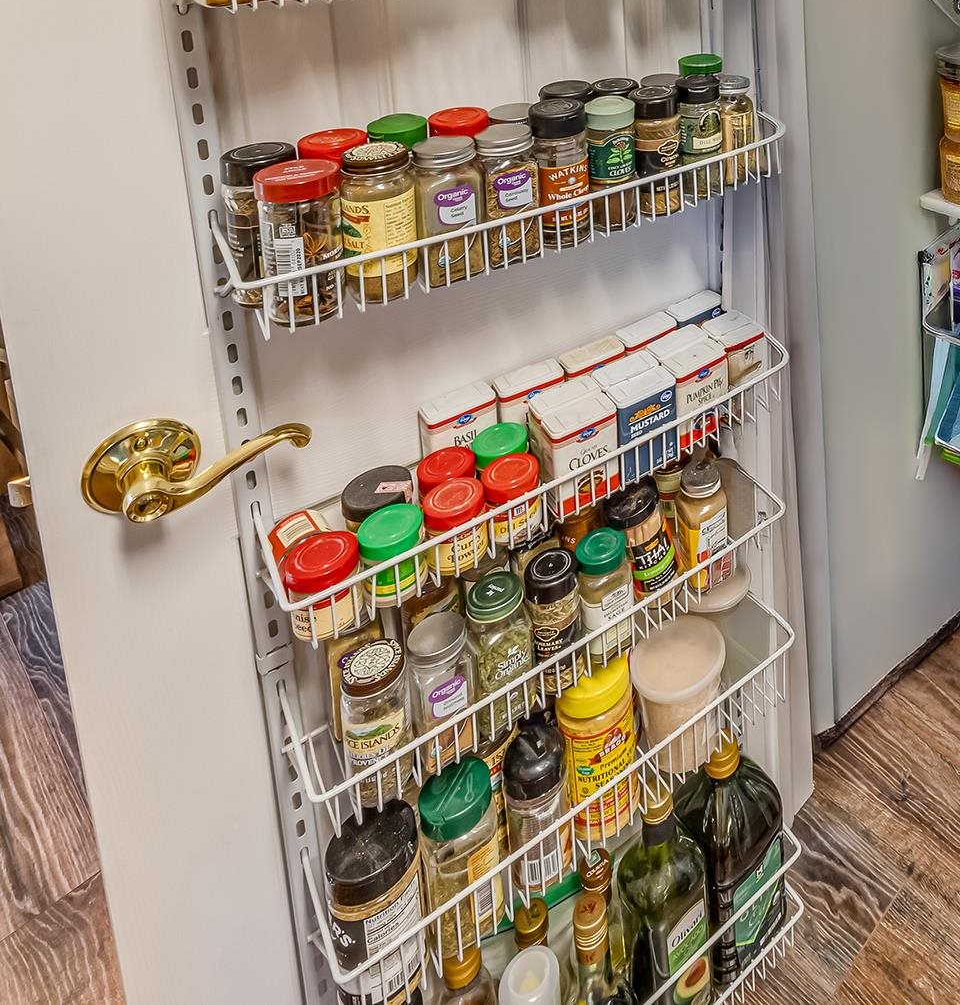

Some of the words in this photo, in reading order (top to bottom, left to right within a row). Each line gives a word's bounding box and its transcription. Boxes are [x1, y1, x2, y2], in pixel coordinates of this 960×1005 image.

[497, 172, 527, 185] Organic
[548, 164, 588, 182] WATKINS
[437, 188, 469, 201] Organic
[547, 190, 573, 201] Whole
[630, 408, 671, 434] MUSTARD
[568, 444, 609, 472] CLOVES
[635, 536, 671, 566] THAI
[494, 654, 531, 681] Organic
[497, 648, 527, 670] Simply
[431, 677, 462, 699] Organic
[360, 724, 401, 750] ISLANDS
[577, 758, 626, 783] NUTRITIONAL
[367, 922, 400, 944] Calories
